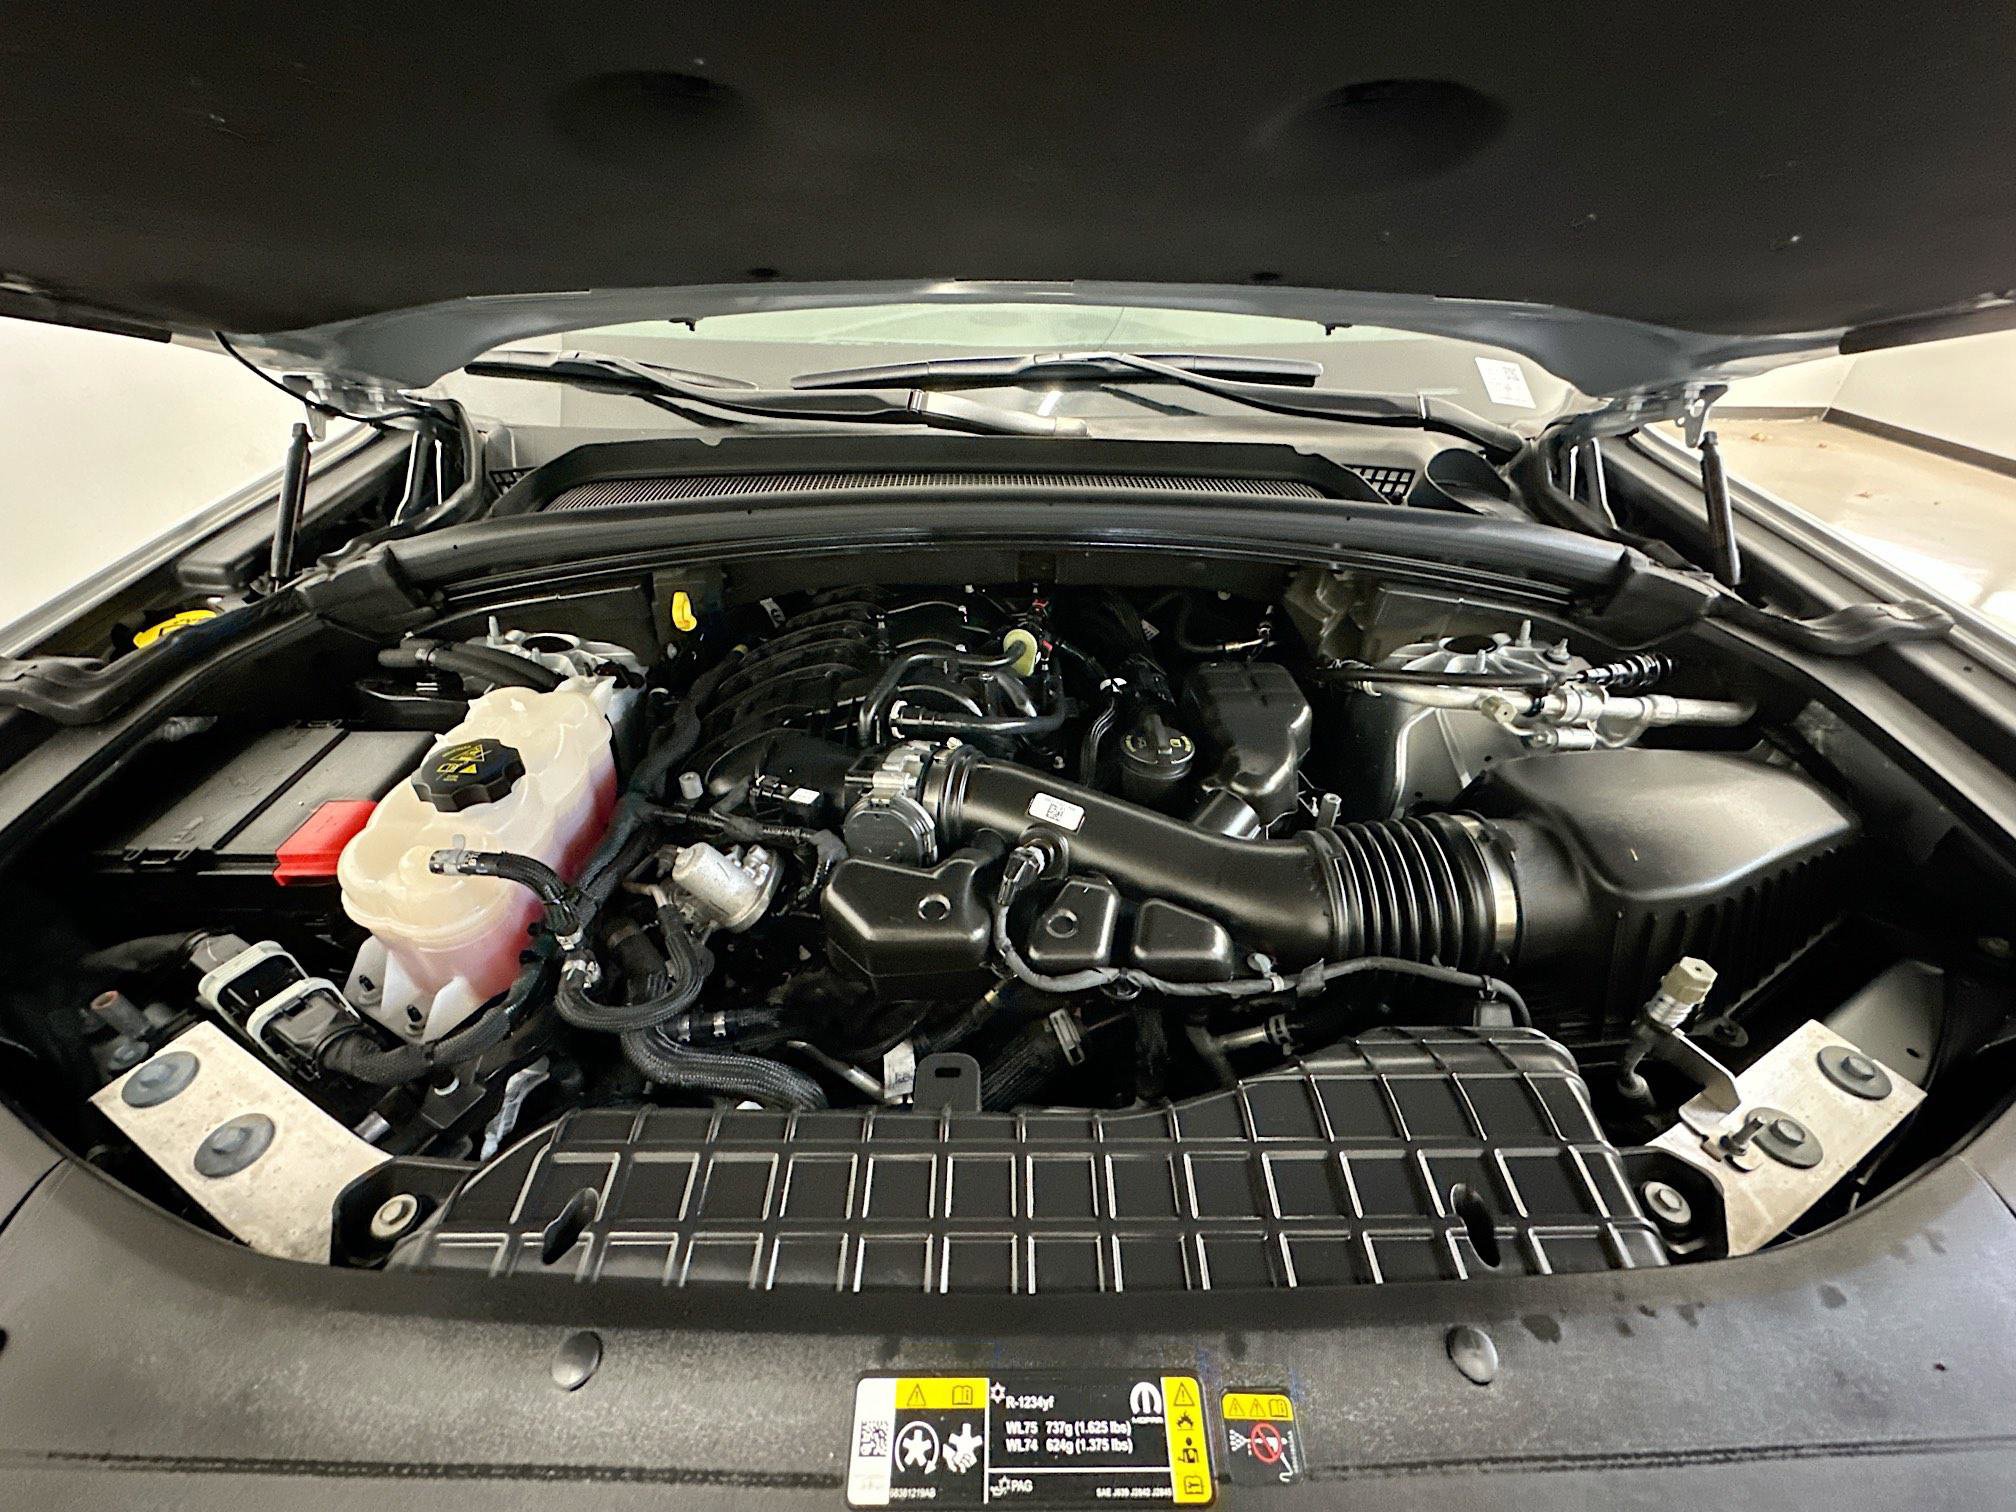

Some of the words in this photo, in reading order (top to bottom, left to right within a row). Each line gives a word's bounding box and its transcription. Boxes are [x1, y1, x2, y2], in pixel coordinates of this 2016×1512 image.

[1006, 1395, 1054, 1411] R-1234yf
[1006, 1421, 1038, 1434] WL75
[1046, 1421, 1073, 1437] 737g
[1075, 1420, 1108, 1437] (1.625
[1110, 1420, 1132, 1437] lbs)
[1006, 1438, 1038, 1452] WL74
[1046, 1438, 1073, 1454] 624g
[1075, 1438, 1109, 1454] (1.375
[1111, 1438, 1133, 1454] lbs)
[1011, 1479, 1033, 1492] PAG
